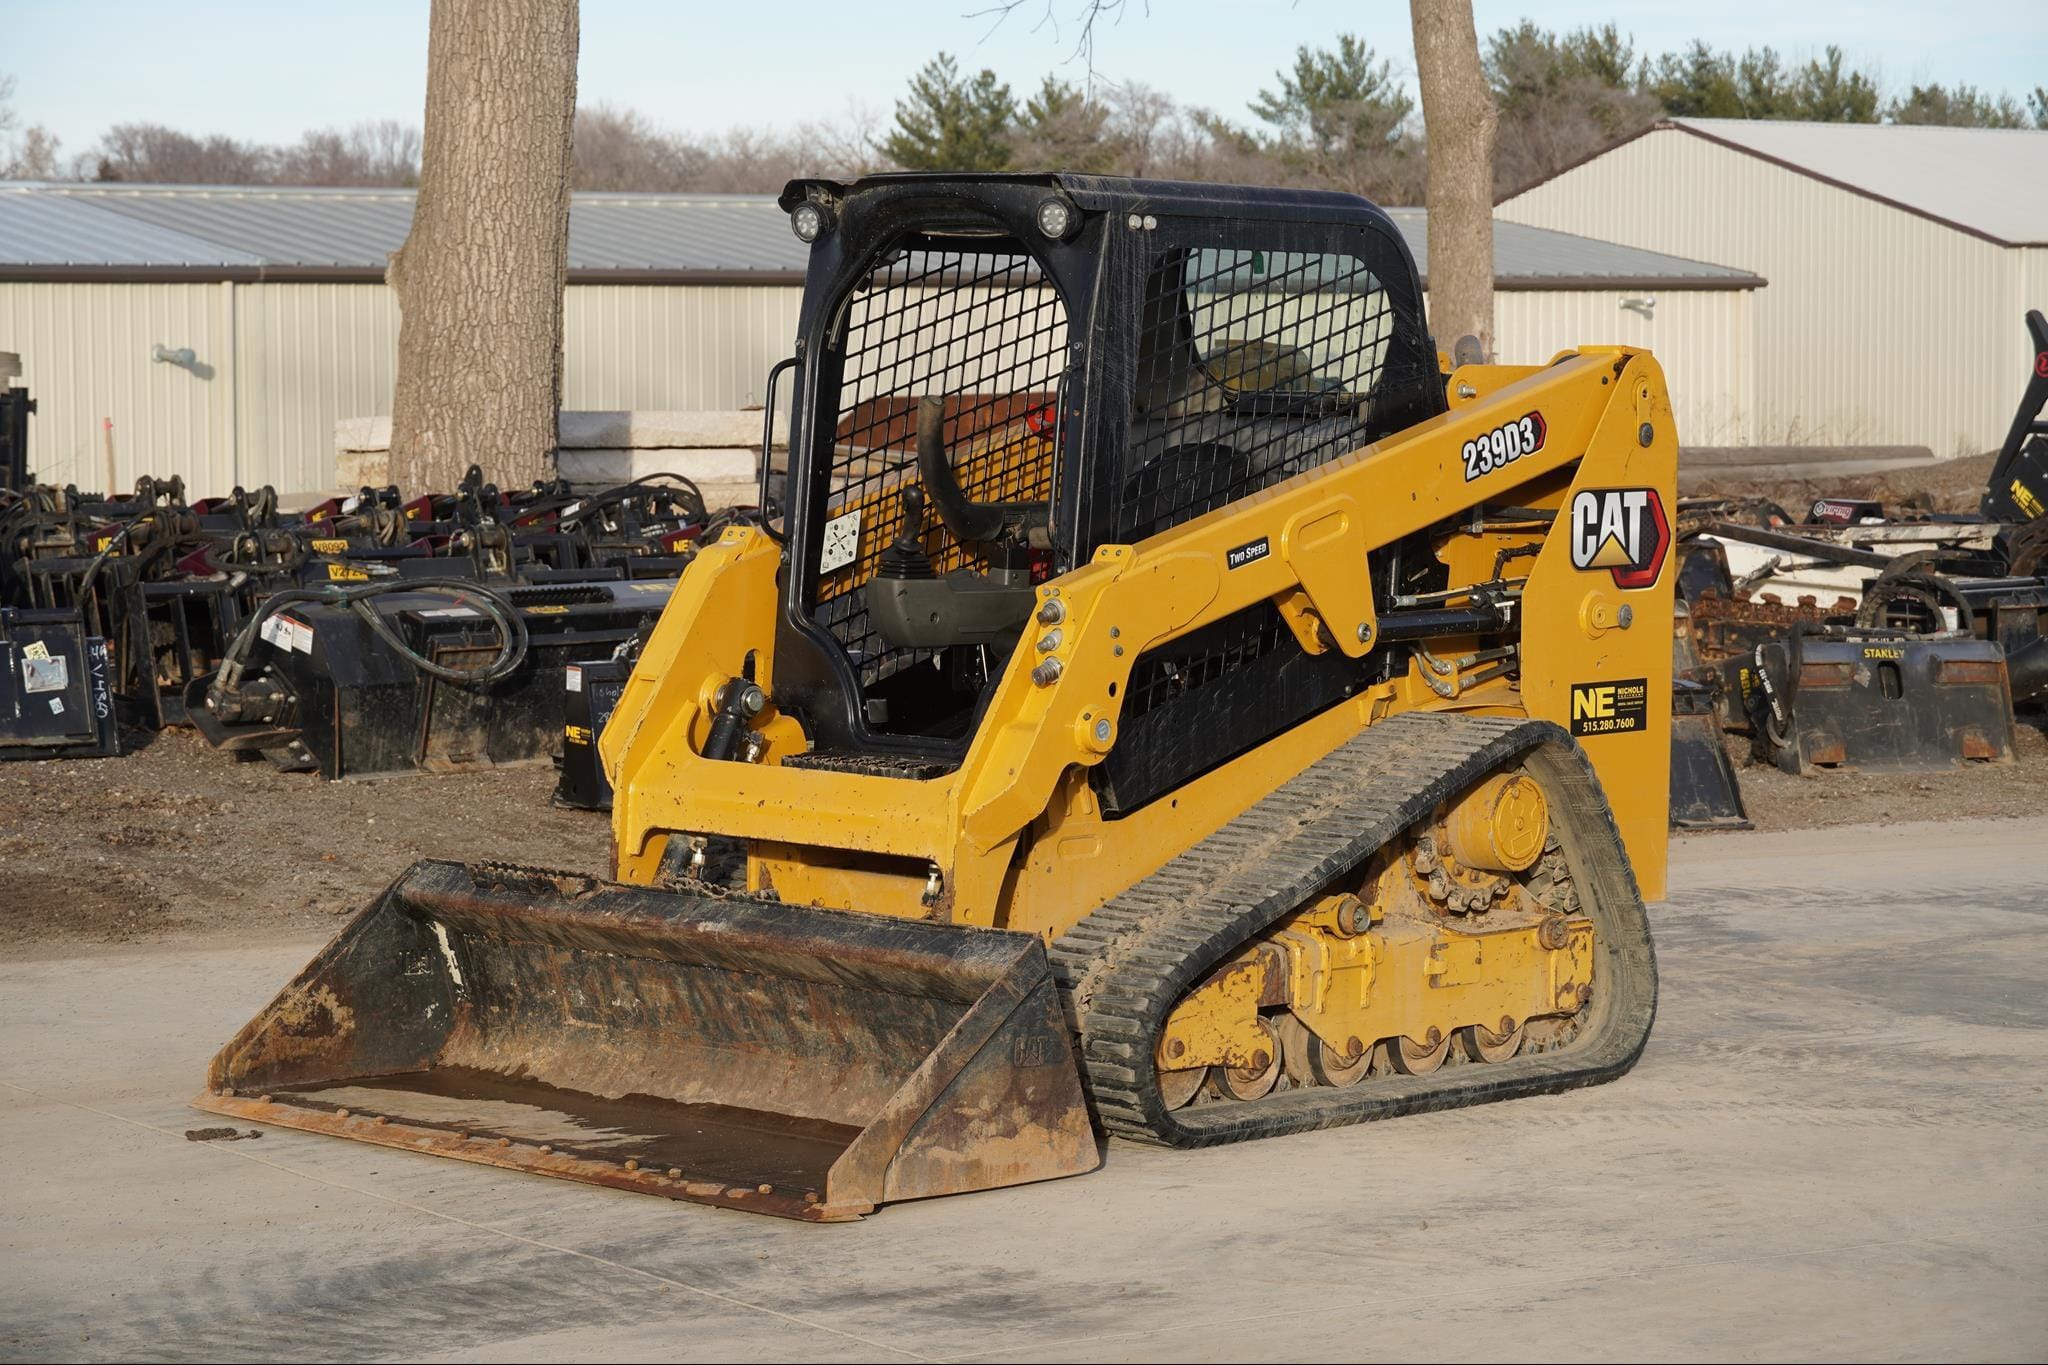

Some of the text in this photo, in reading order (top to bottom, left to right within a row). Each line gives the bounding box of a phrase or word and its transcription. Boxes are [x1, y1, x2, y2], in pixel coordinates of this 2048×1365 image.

[1462, 416, 1535, 481] 239D3
[1572, 491, 1647, 568] CAT
[1863, 648, 1905, 659] STANLEY
[1573, 685, 1644, 721] NE NICHOLS
[565, 724, 581, 739] NE
[1582, 717, 1635, 732] 515.280.7600
